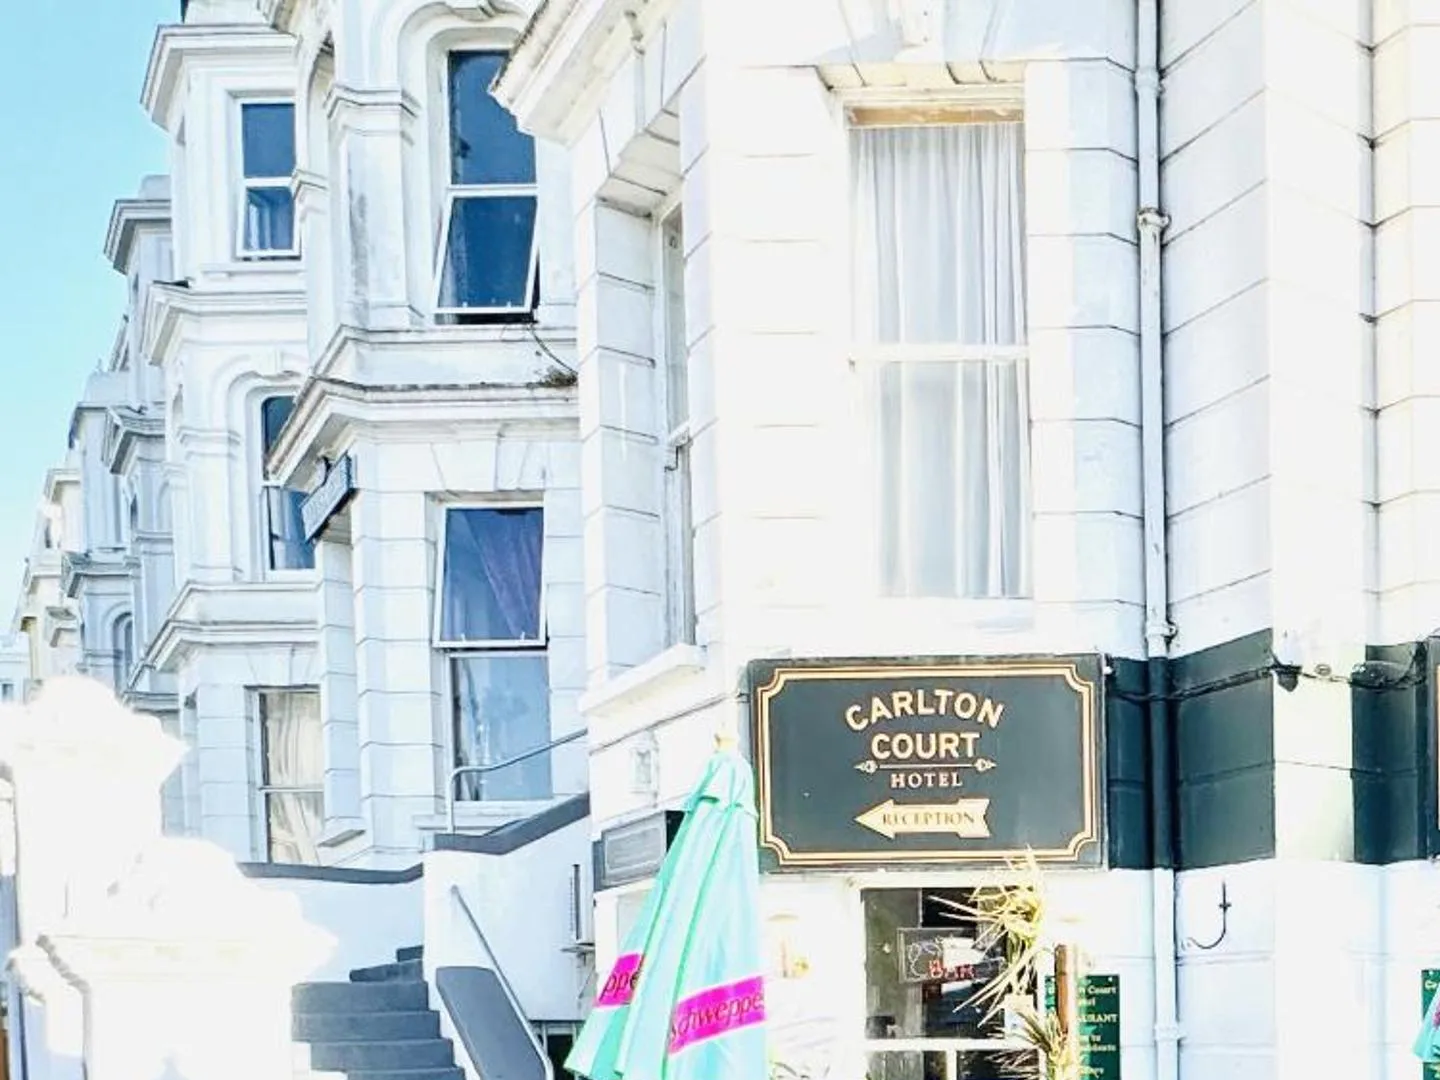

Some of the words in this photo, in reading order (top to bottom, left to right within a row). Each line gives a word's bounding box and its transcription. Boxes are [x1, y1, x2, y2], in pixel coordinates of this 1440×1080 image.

[845, 688, 1004, 731] CARLTON
[871, 732, 981, 760] COURT
[891, 772, 964, 789] HOTEL
[882, 811, 976, 827] RECEPTION
